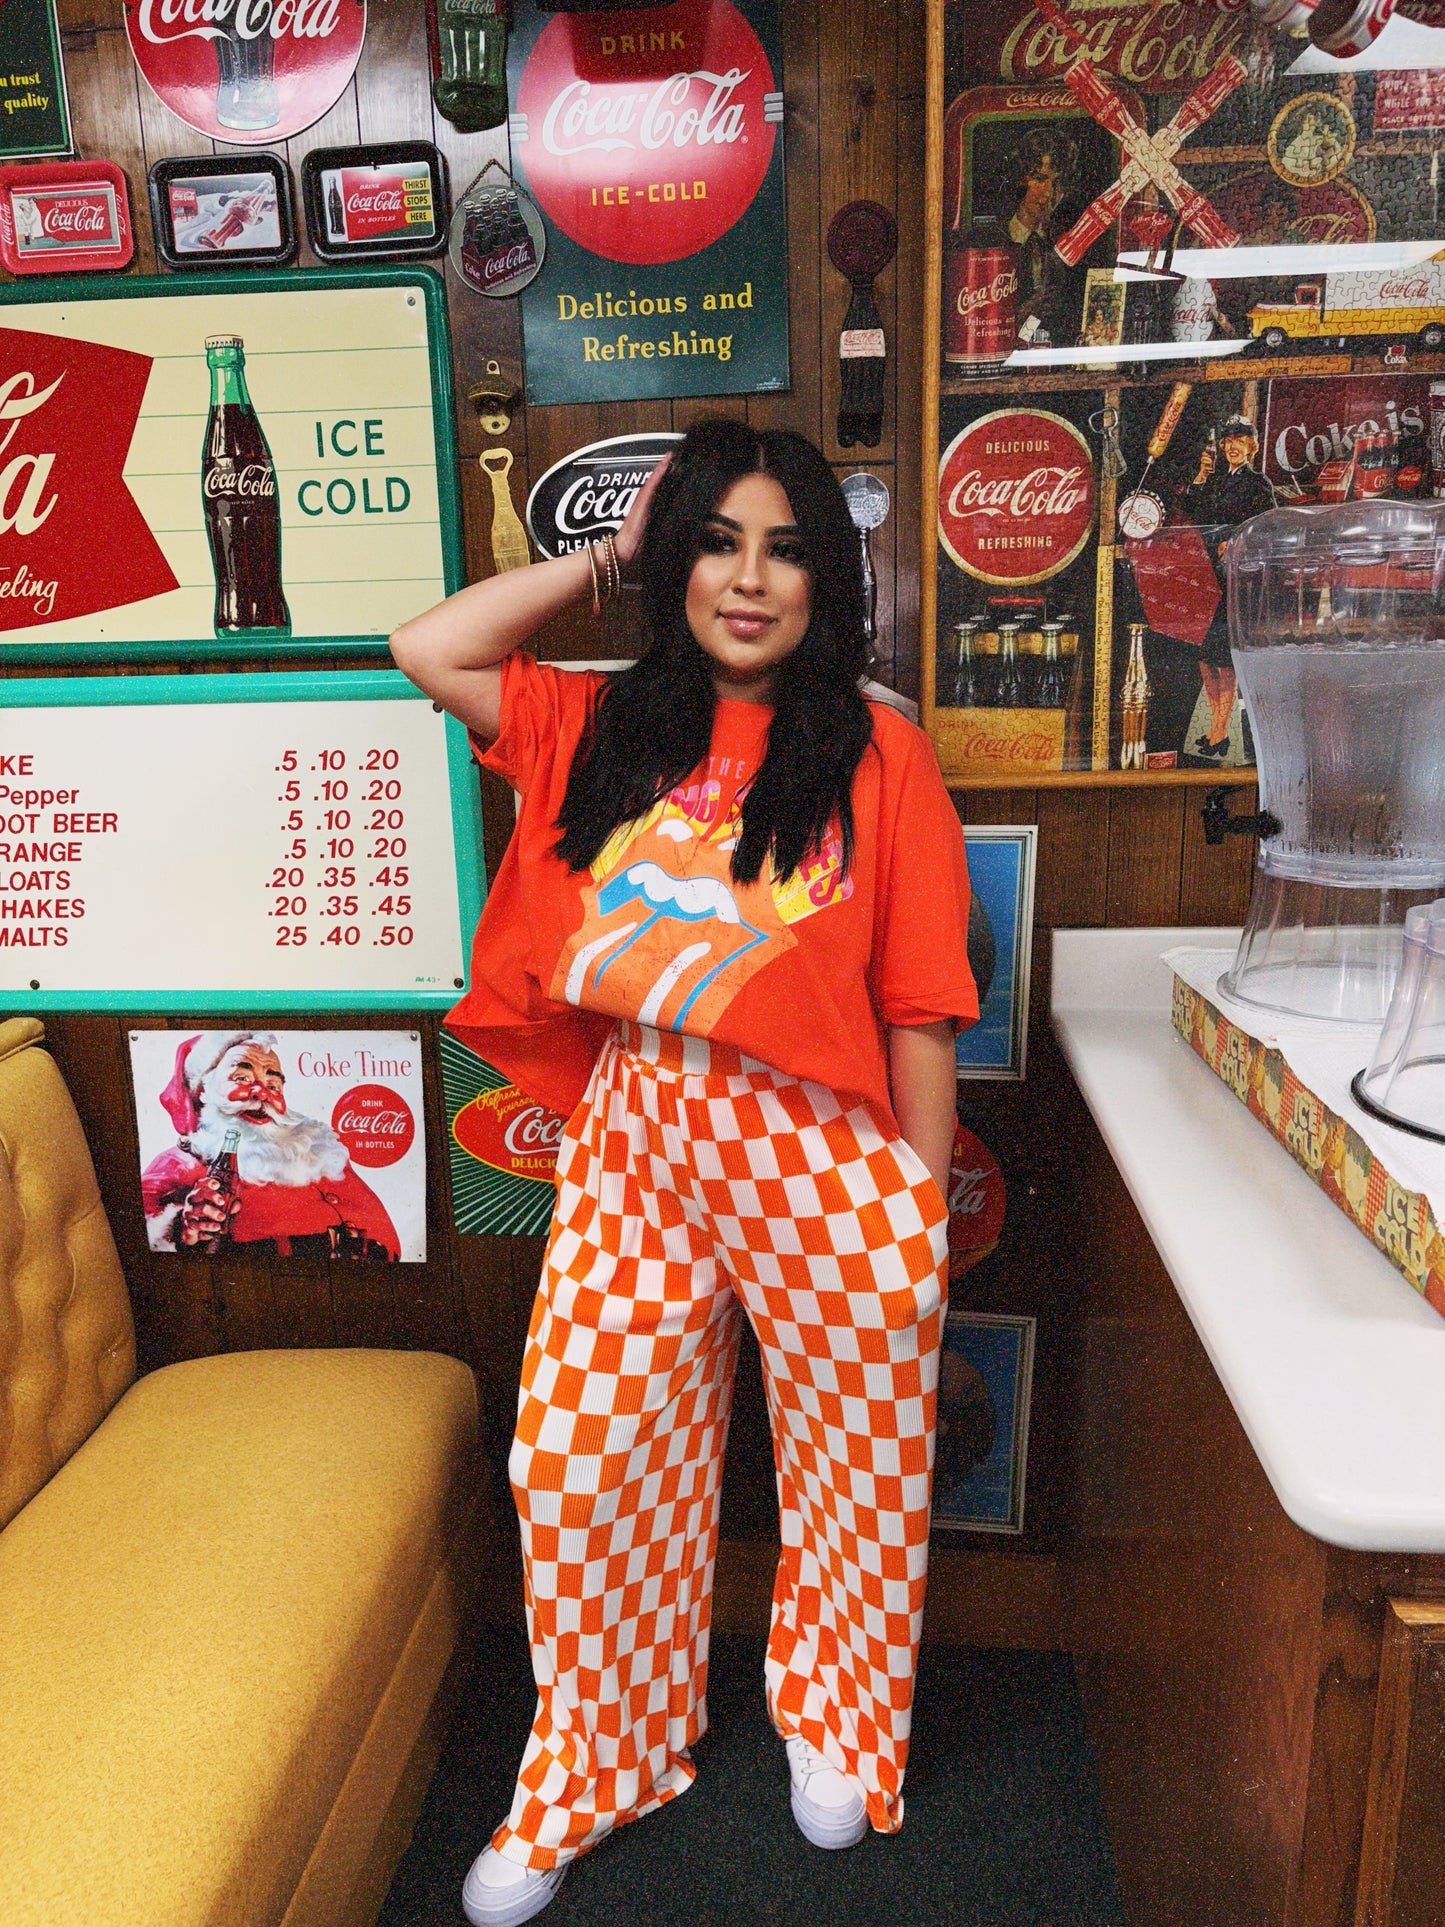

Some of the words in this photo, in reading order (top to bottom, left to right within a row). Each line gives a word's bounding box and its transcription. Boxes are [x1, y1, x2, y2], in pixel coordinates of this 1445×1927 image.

[601, 31, 686, 55] DRINK
[1000, 0, 1242, 83] Coca-Col
[10, 72, 42, 86] trust
[4, 92, 49, 114] quality
[542, 68, 753, 156] Coca-Cola
[404, 180, 427, 190] THIRST
[592, 181, 707, 206] ICE-COLD
[347, 190, 402, 213] Coca-Cola
[406, 196, 428, 206] STOPS
[44, 206, 104, 233] Coca-Cola
[410, 212, 427, 221] HERE
[485, 242, 527, 278] Coca-Cola
[557, 291, 688, 320] Delicious
[703, 282, 754, 310] and
[957, 268, 1018, 315] Coca-Cola
[1379, 279, 1430, 299] Coca-Cola
[964, 316, 1002, 326] Delicious
[969, 328, 1012, 338] Refreshing
[582, 331, 734, 363] Refreshing
[315, 419, 386, 458] ICE
[986, 440, 1050, 454] DELICIOUS
[1275, 419, 1381, 472] Coke
[1384, 400, 1425, 437] is
[204, 464, 276, 498] Coca-Cola
[948, 466, 1088, 518] Coca-Cola
[297, 476, 412, 516] COLD
[978, 536, 1053, 550] REFRESHING
[0, 564, 59, 616] eling
[963, 733, 1056, 760] Coca-Cola
[274, 750, 298, 772] .5
[310, 749, 346, 771] .10
[358, 749, 399, 771] .20
[709, 757, 746, 779] THE
[0, 785, 79, 809] Pepper
[277, 780, 301, 801] .5
[313, 780, 349, 801] .10
[361, 779, 402, 800] .20
[53, 812, 119, 834] BEER
[280, 810, 303, 831] .5
[316, 810, 351, 830] .10
[364, 809, 404, 830] .20
[0, 842, 82, 863] RANGE
[284, 838, 307, 859] .5
[319, 838, 355, 859] .10
[367, 837, 407, 858] .20
[265, 867, 305, 888] .20
[316, 866, 356, 888] .35
[369, 866, 409, 887] .45
[268, 896, 308, 916] .20
[319, 895, 359, 916] .35
[371, 895, 412, 916] .45
[276, 926, 307, 946] 25
[320, 926, 361, 946] .40
[373, 926, 414, 946] .50
[298, 1051, 352, 1077] Coke
[354, 1050, 412, 1077] Time
[1220, 1052, 1250, 1094] COLD
[338, 1110, 409, 1134] Coca-Cola
[1293, 1092, 1318, 1134] ICE
[365, 1140, 395, 1149] BOTTLES
[1285, 1117, 1322, 1170] COLD
[1385, 1182, 1422, 1230] ICE
[1374, 1209, 1426, 1276] COLD
